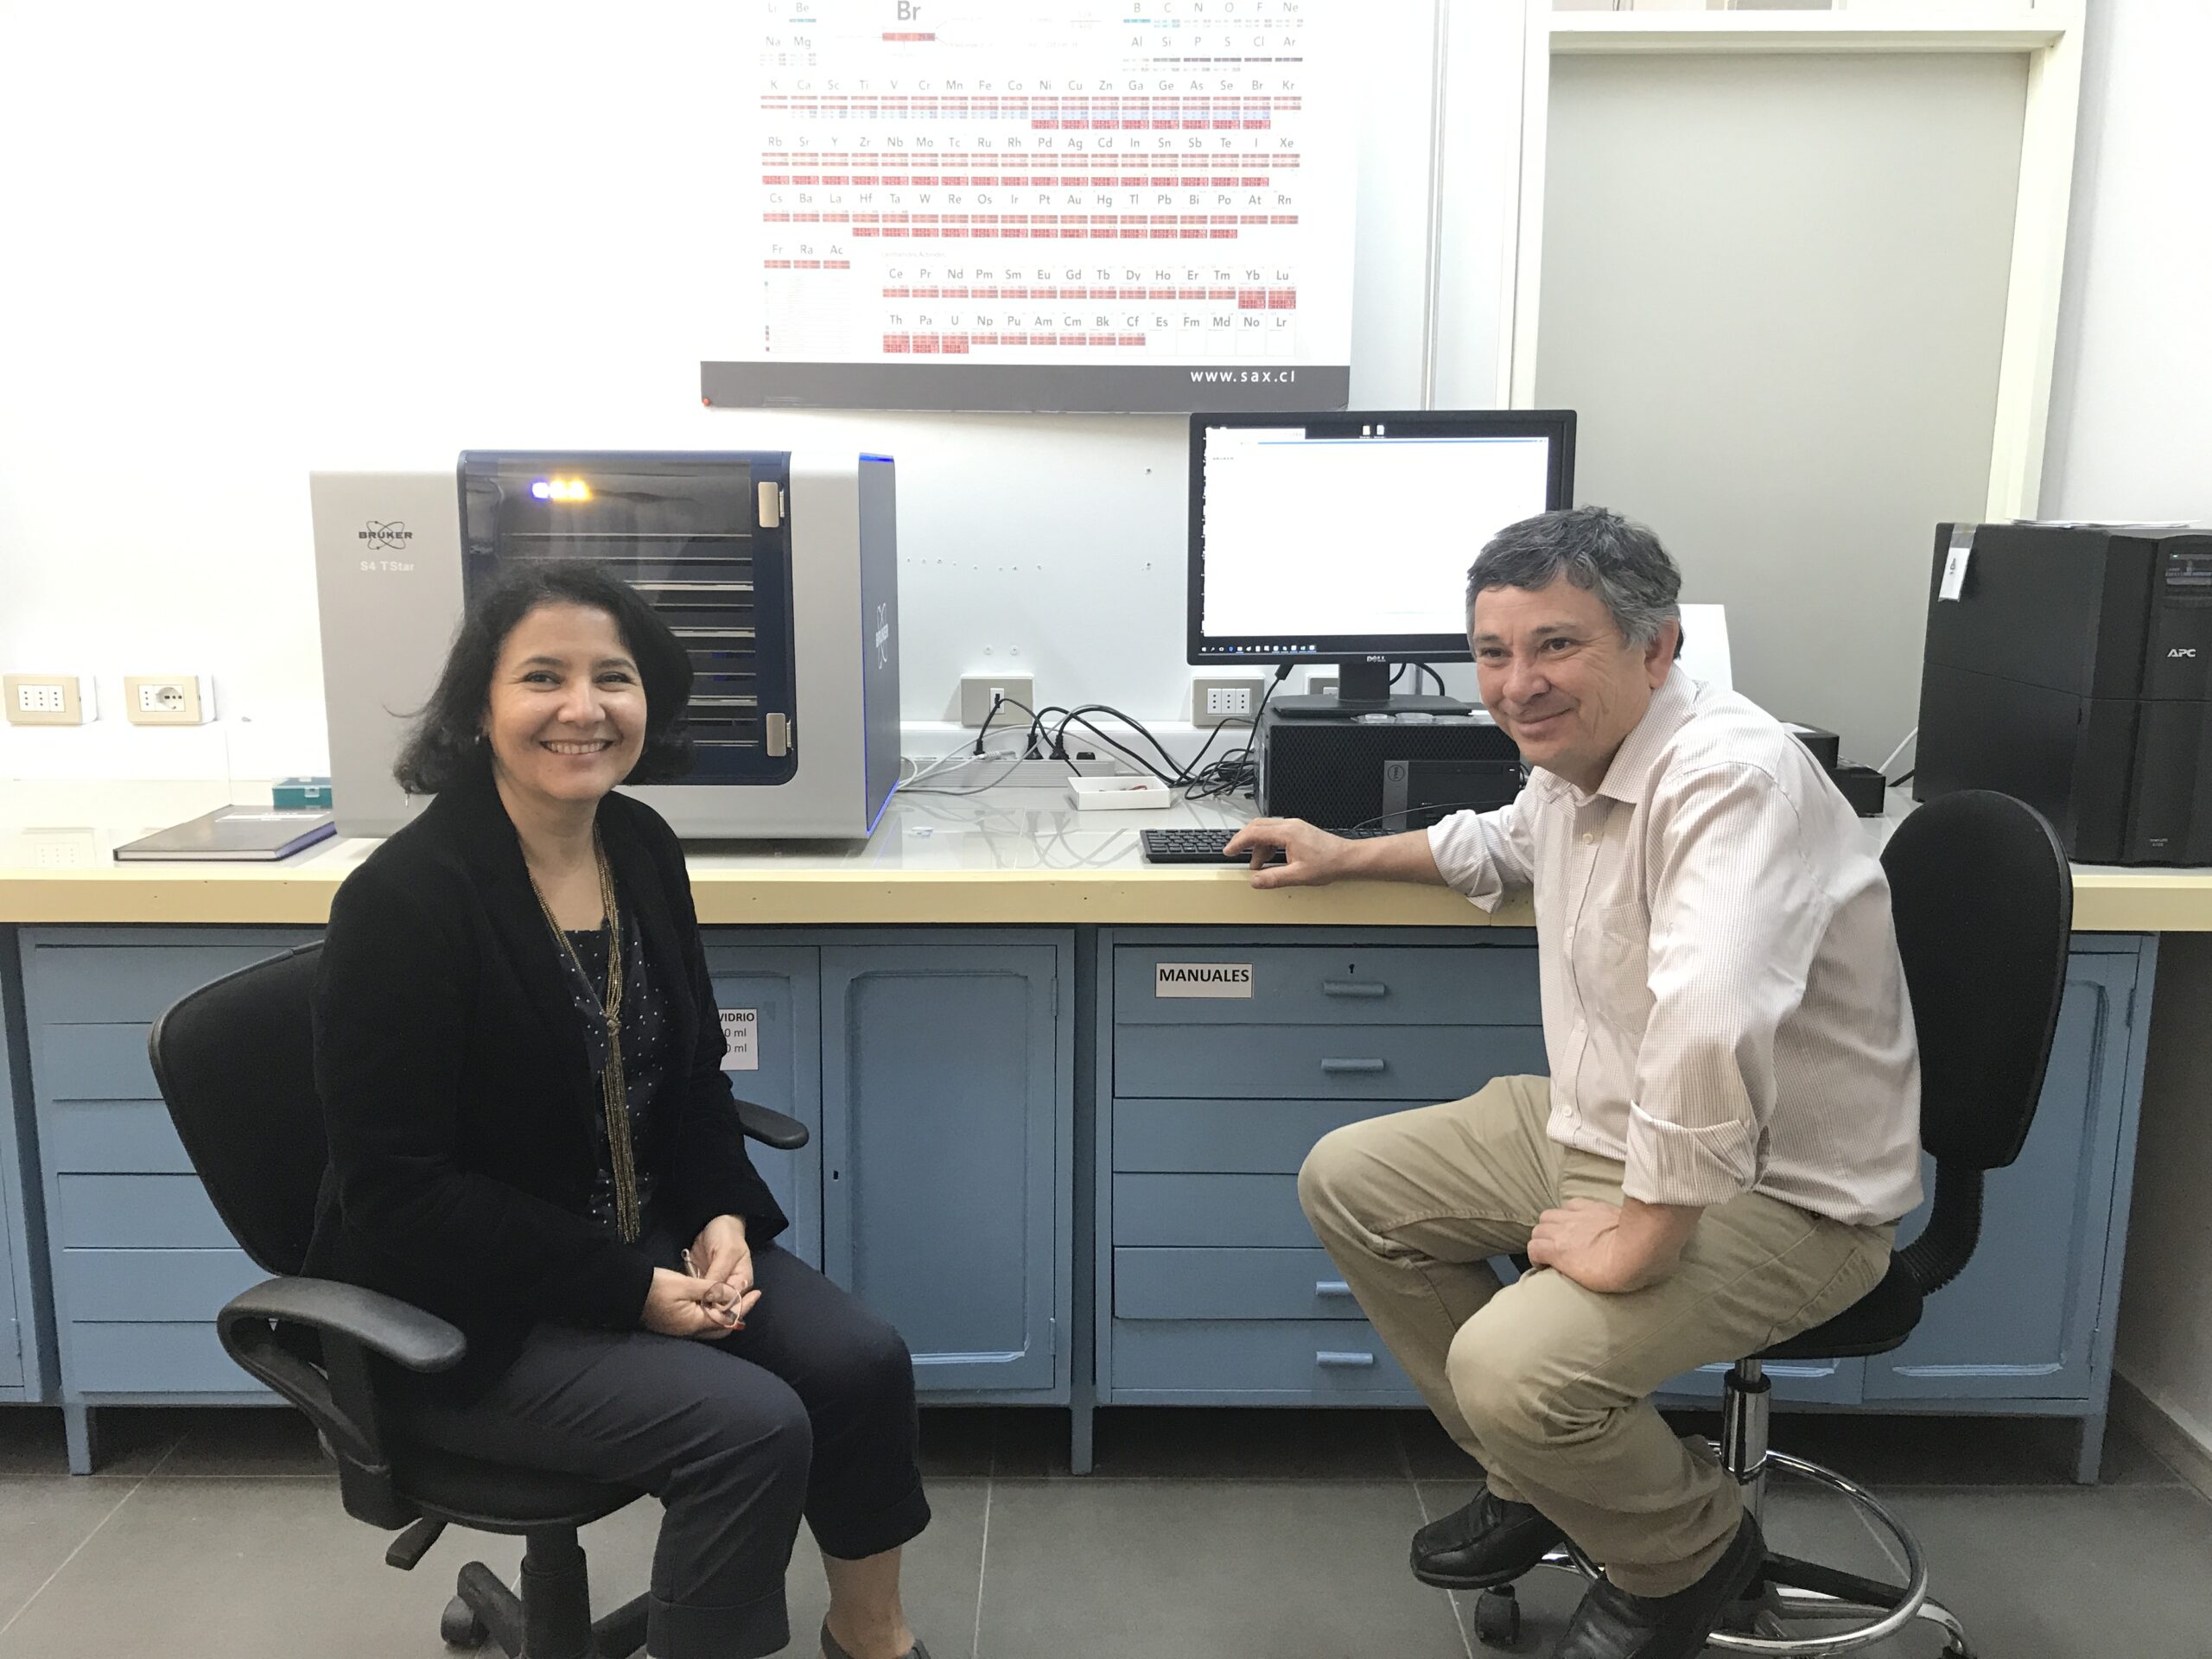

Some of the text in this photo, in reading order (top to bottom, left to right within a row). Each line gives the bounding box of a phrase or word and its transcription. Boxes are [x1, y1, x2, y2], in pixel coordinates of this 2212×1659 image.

[796, 3, 810, 12] Be
[897, 0, 921, 21] Br
[1134, 2, 1299, 13] B C N O F Ne
[766, 36, 811, 49] Na Mg
[1161, 36, 1172, 47] Si
[1194, 36, 1202, 47] P
[1224, 36, 1231, 47] S
[1284, 37, 1296, 46] Ar
[770, 80, 779, 89] K
[798, 79, 811, 90] Ca
[859, 79, 868, 90] Ti
[890, 80, 899, 89] V
[918, 80, 931, 90] Cr
[946, 80, 963, 90] Mn
[979, 80, 992, 90] Fe
[1008, 80, 1023, 90] Co
[1040, 80, 1052, 90] Ni
[1068, 80, 1083, 90] Cu
[1099, 80, 1113, 90] Zn
[1128, 80, 1144, 90] Ga
[1159, 80, 1174, 90] Ge
[1191, 80, 1204, 90] As
[1221, 80, 1234, 90] Se
[1252, 80, 1264, 90] Br
[1283, 80, 1295, 90] Kr
[768, 137, 783, 146] Rb
[798, 137, 810, 147] Sr
[860, 137, 871, 147] Zr
[887, 137, 904, 147] Nb
[917, 137, 934, 147] Mo
[949, 137, 960, 147] Tc
[978, 137, 992, 147] Ru
[1008, 137, 1022, 147] Rh
[1039, 137, 1052, 147] Pd
[1068, 138, 1084, 150] Ag
[1098, 137, 1113, 148] Cd
[1129, 138, 1141, 147] In
[1159, 137, 1172, 148] Sn
[1189, 137, 1203, 148] Sb
[1220, 137, 1231, 148] Te
[1280, 138, 1294, 148] Xe
[770, 193, 784, 203] Cs
[800, 194, 813, 203] Ba
[830, 194, 842, 203] La
[861, 193, 873, 203] Hf
[889, 194, 900, 203] Ta
[919, 194, 931, 203] W
[949, 194, 962, 204] Re
[977, 194, 993, 204] Os
[1011, 194, 1019, 204] Ir
[1039, 194, 1051, 204] Pt
[1067, 194, 1082, 204] Au
[1097, 194, 1113, 207] Hg
[1158, 194, 1173, 205] Pb
[1189, 194, 1200, 205] Bi
[1218, 194, 1232, 205] Po
[1249, 194, 1262, 205] At
[1278, 194, 1292, 205] Rn
[772, 245, 843, 255] Fr Ra Ac
[889, 269, 1289, 281] Ce Pr Nd Pm Sm Eu Gd Tb Dy Ho Er Tm Yb Lu
[890, 315, 1287, 327] Th Pa U Np Pu Am Cm Bk Cf Es Fm Md No Lr
[1190, 371, 1295, 383] www.sax.cl
[360, 561, 376, 571] S4
[1160, 969, 1249, 982] MANUALES
[734, 1027, 747, 1037] ml
[734, 1044, 747, 1052] ml
